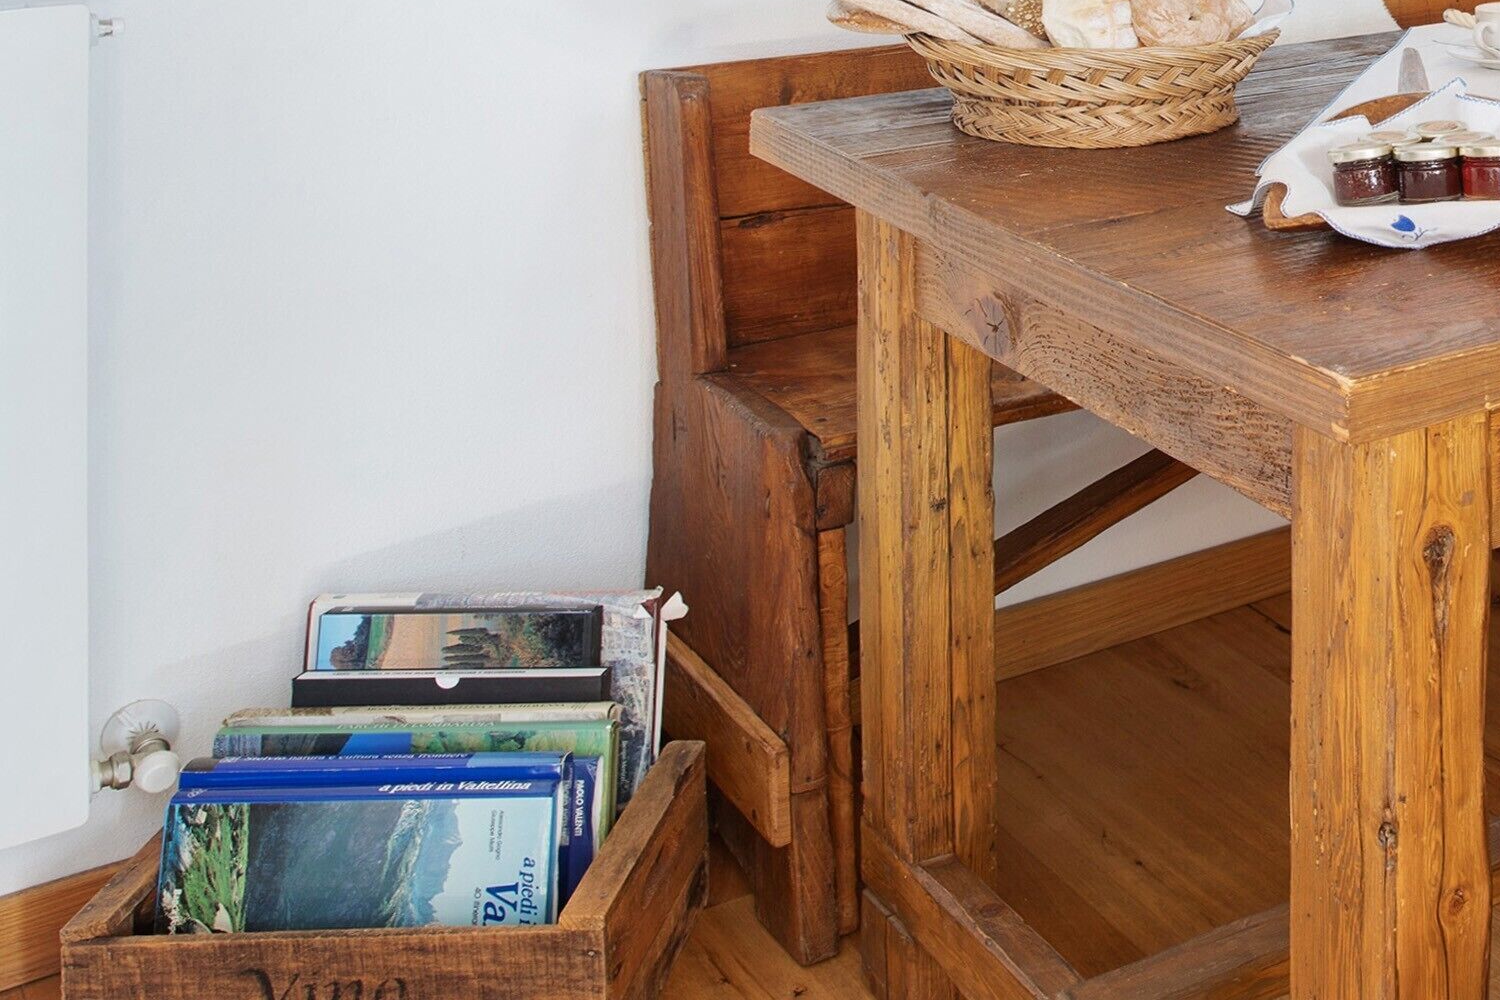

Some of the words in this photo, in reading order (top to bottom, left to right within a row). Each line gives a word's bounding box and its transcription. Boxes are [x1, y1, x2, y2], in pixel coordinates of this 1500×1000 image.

[389, 781, 437, 794] piedi
[436, 781, 455, 791] in
[458, 780, 533, 791] Valtellina
[574, 779, 585, 806] PAOLO
[574, 806, 585, 837] VALENTI
[523, 857, 536, 868] a
[519, 871, 540, 916] piedi
